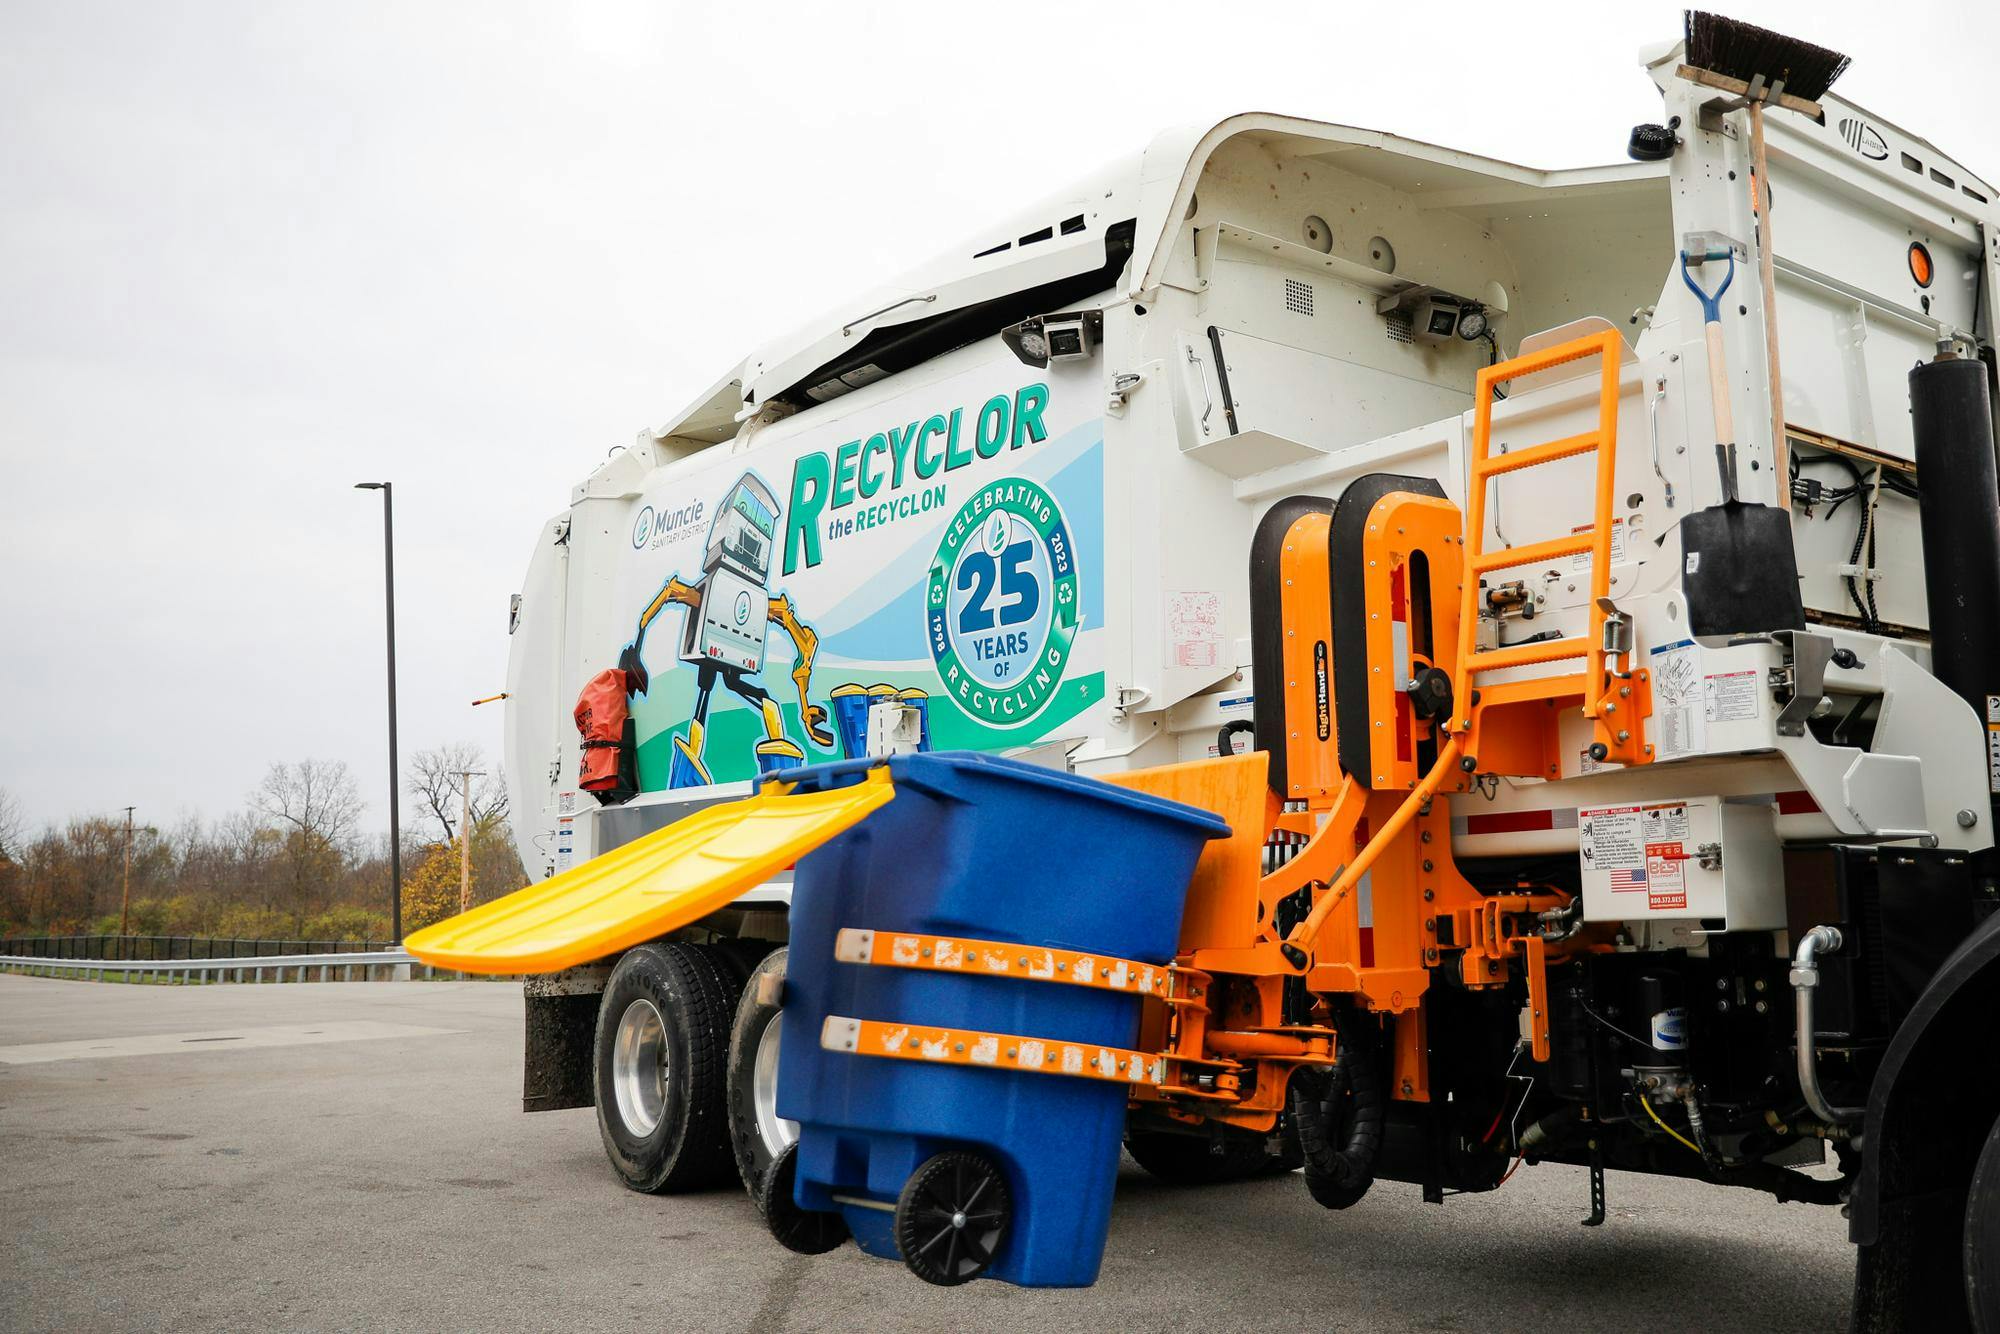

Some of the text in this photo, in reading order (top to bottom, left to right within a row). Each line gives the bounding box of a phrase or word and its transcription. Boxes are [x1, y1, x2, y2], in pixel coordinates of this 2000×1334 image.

[781, 382, 1050, 577] RECYCLOR
[654, 498, 704, 537] Muncie
[829, 484, 947, 541] the RECYCLON
[947, 485, 1051, 549] CELEBRATING
[651, 520, 710, 551] SANITARY DISTRICT
[1050, 532, 1068, 573] 2023
[957, 539, 1040, 634] 25
[932, 615, 946, 653] 1998
[973, 631, 1029, 662] YEARS
[948, 647, 1062, 715] RECYCLING
[994, 663, 1010, 678] OF
